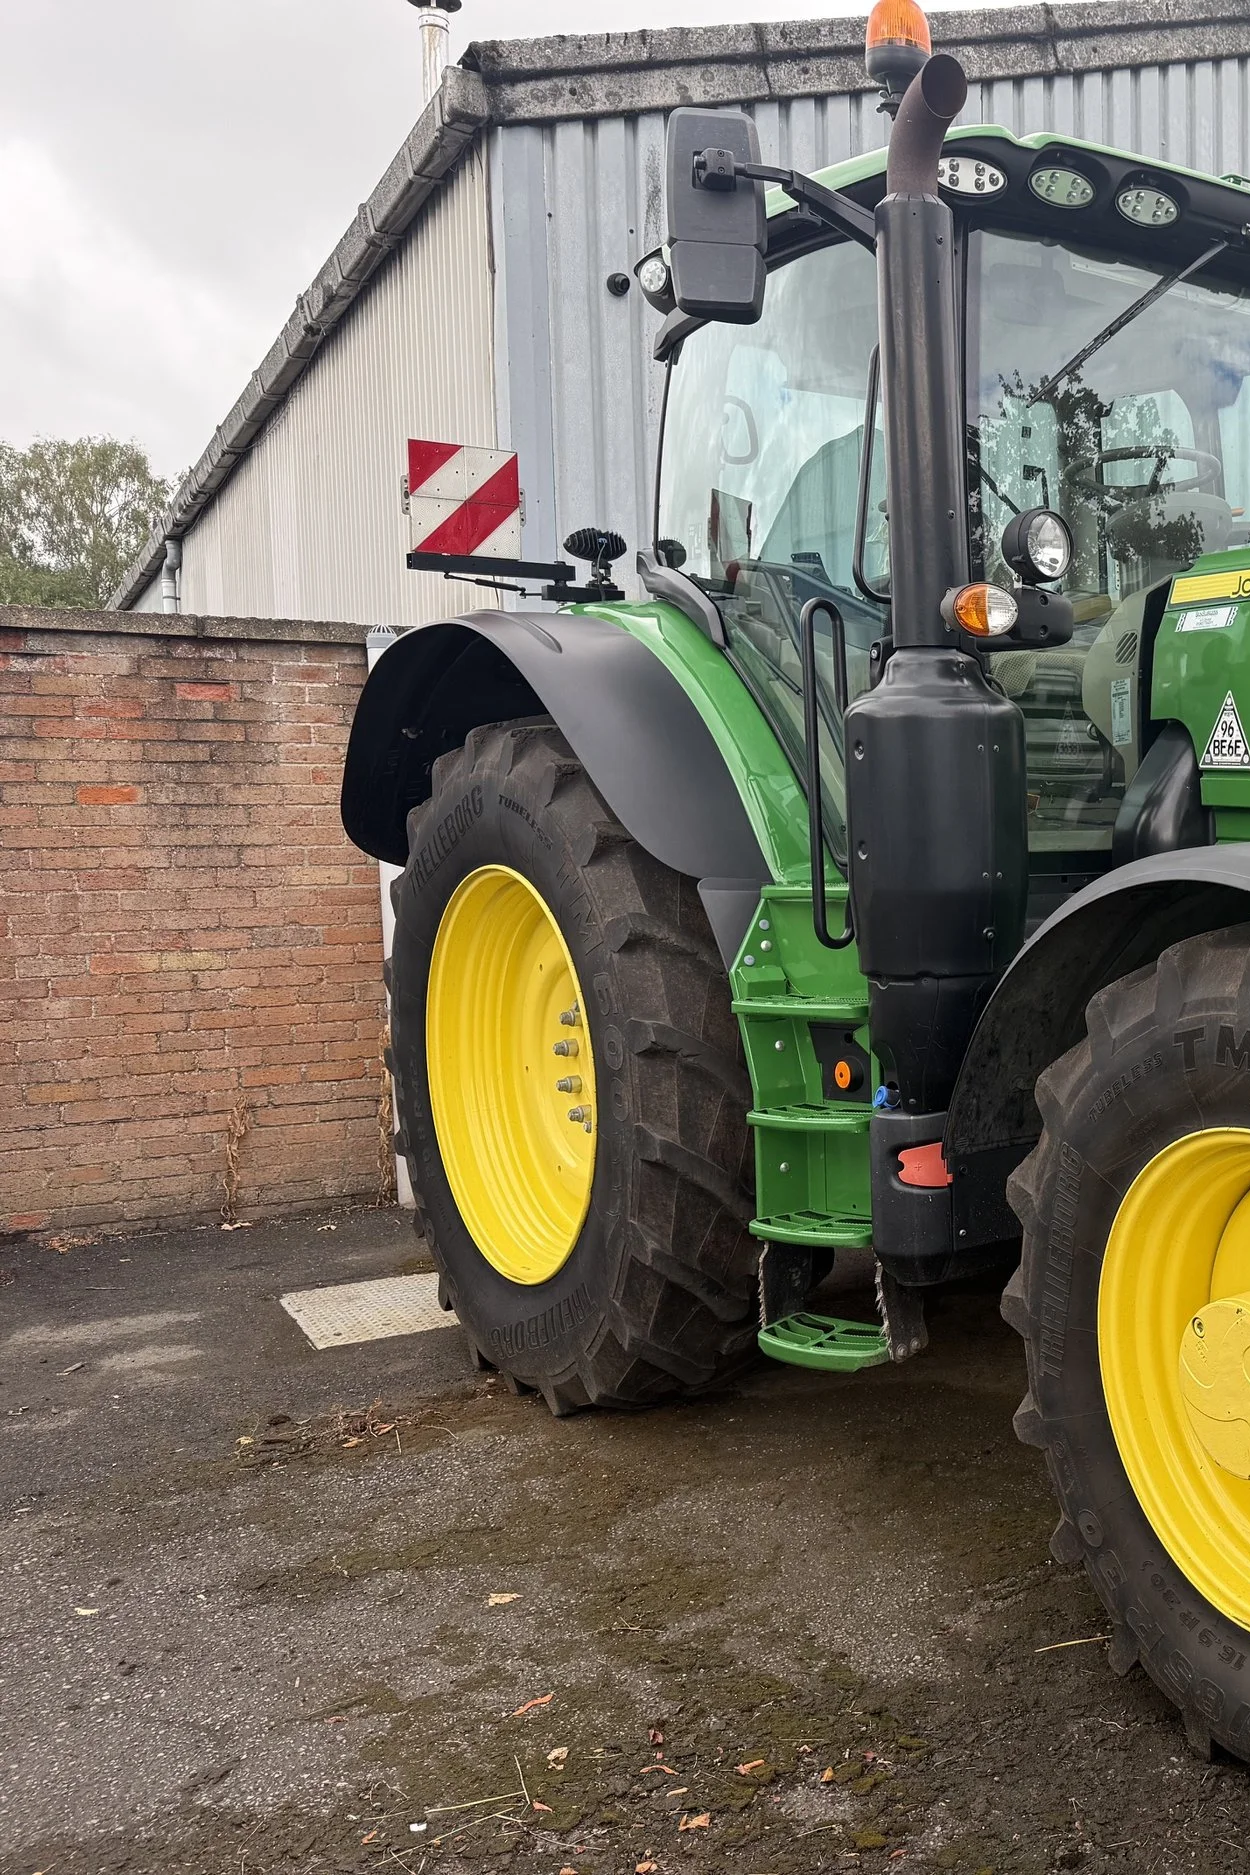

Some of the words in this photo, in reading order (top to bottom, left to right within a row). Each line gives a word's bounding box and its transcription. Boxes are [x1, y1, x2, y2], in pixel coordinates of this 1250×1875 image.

[1212, 739, 1242, 757] BE6E
[1220, 720, 1235, 738] 96
[409, 785, 484, 896] TRELLEBORG
[1087, 1051, 1163, 1122] TUBELESS
[1039, 1141, 1085, 1379] TRELLEBORG
[490, 1281, 599, 1360] TRELLEBORG
